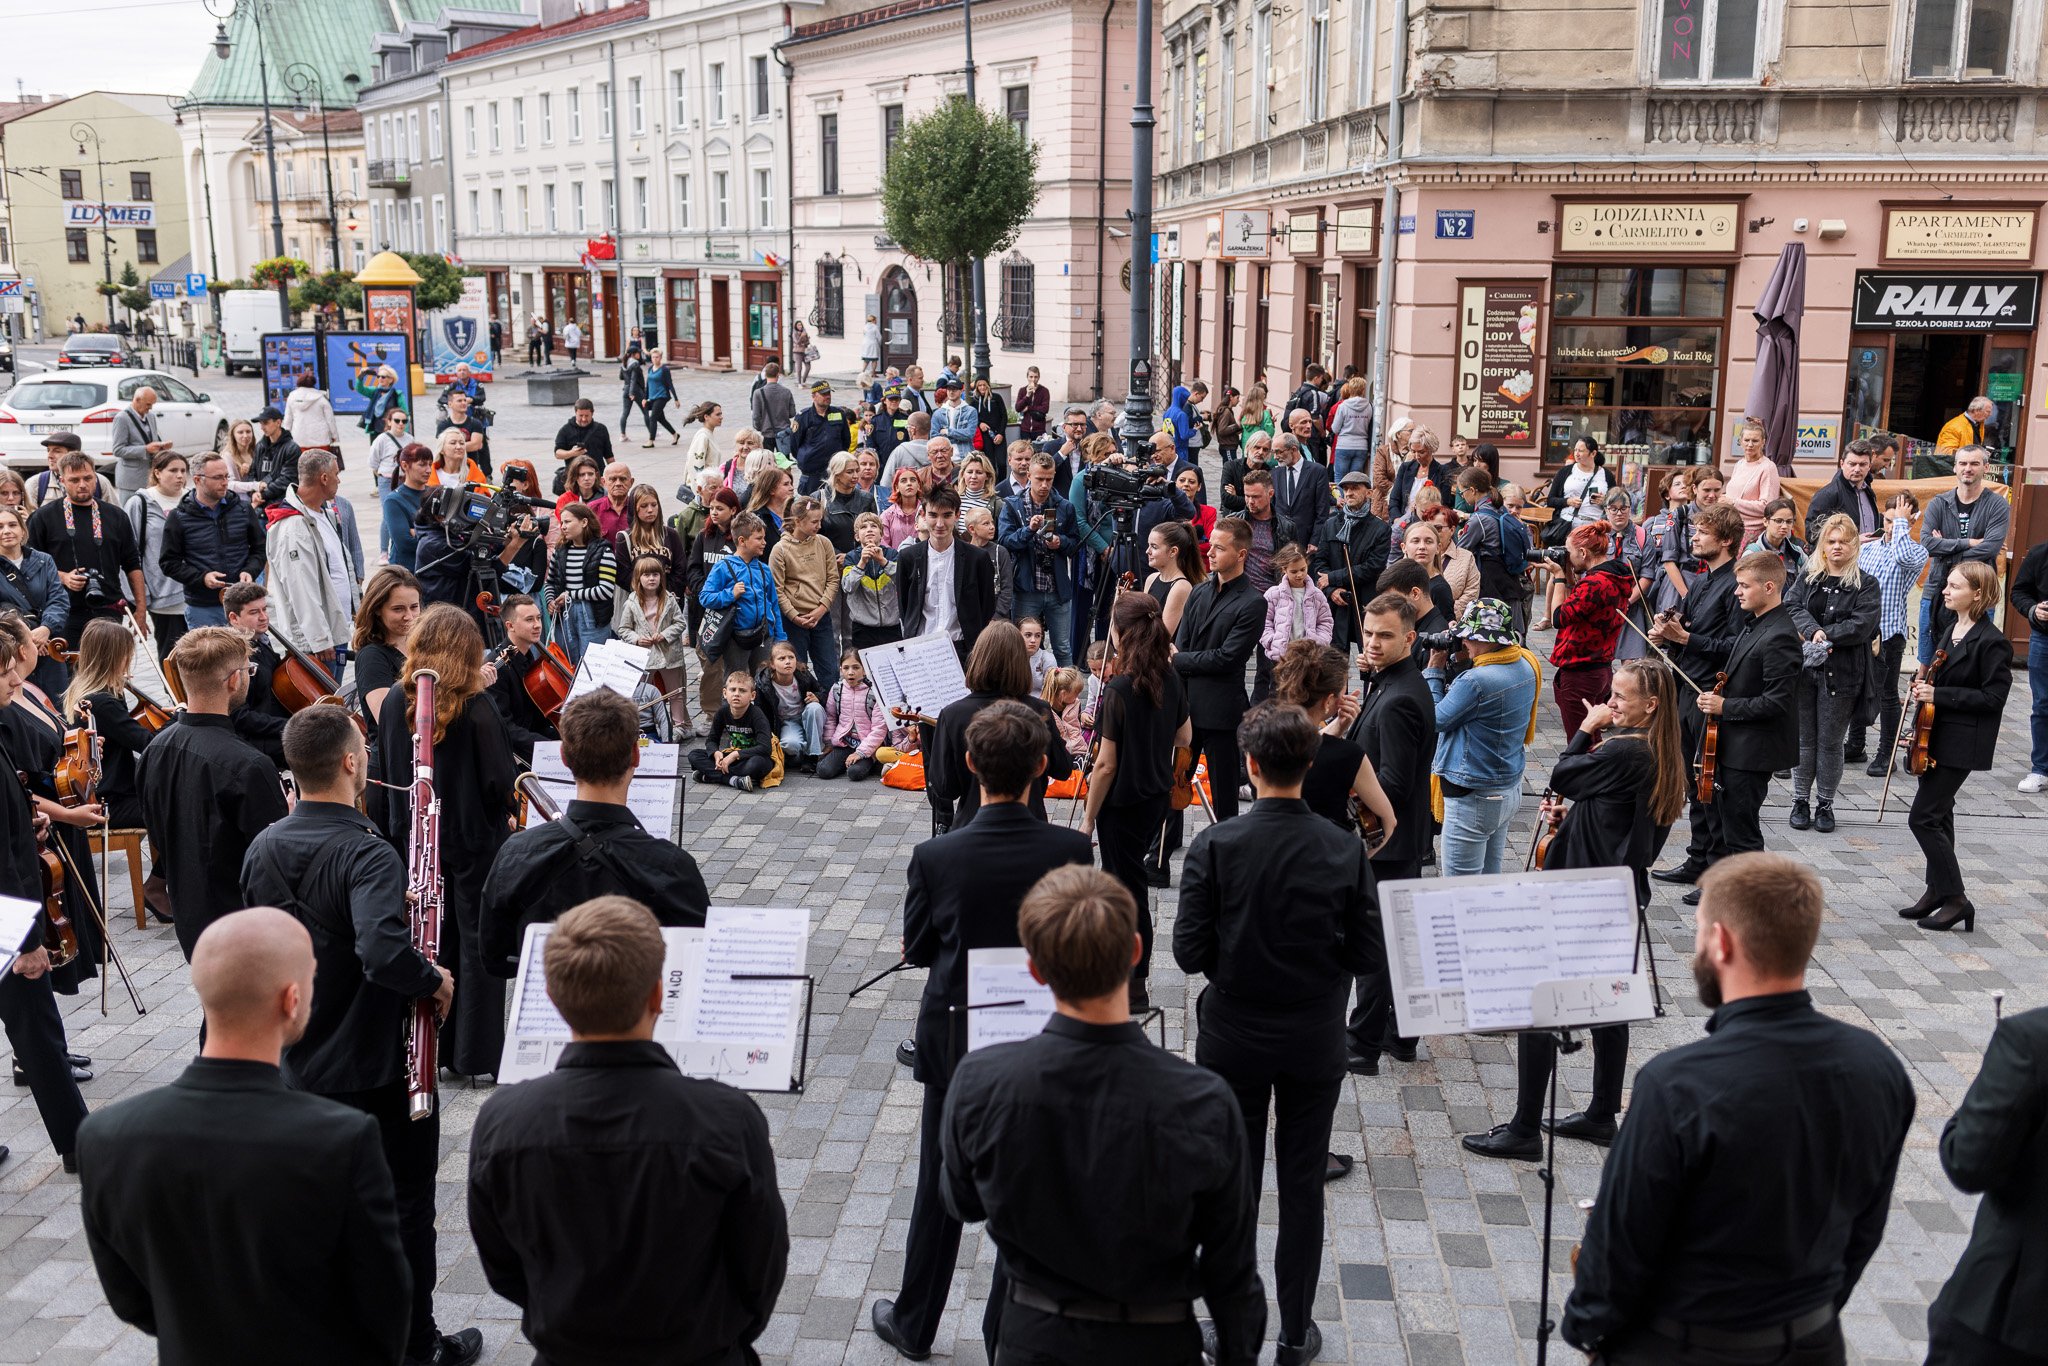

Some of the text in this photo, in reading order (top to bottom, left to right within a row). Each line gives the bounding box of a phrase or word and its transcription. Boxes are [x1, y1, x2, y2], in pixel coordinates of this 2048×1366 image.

[1593, 207, 1706, 222] LODZIARNIA
[1457, 218, 1467, 236] 2
[1895, 215, 2027, 228] APARTAMENTY
[1609, 223, 1689, 239] CARMELITO
[1934, 229, 1984, 239] CARMELITO
[0, 281, 21, 295] AXI
[153, 282, 173, 293] TAXI
[191, 275, 203, 291] P
[1875, 285, 2019, 316] RALLY
[1895, 320, 1993, 328] SZKOŁA DOBREJ JAZDY
[1485, 332, 1514, 341] LODY
[1557, 345, 1637, 357] lubelskie ciasteczko
[1673, 350, 1713, 363] Kozi Róg
[1483, 367, 1517, 377] GOFRY
[1481, 410, 1527, 419] SORBETY
[1800, 440, 1831, 448] KOMIS
